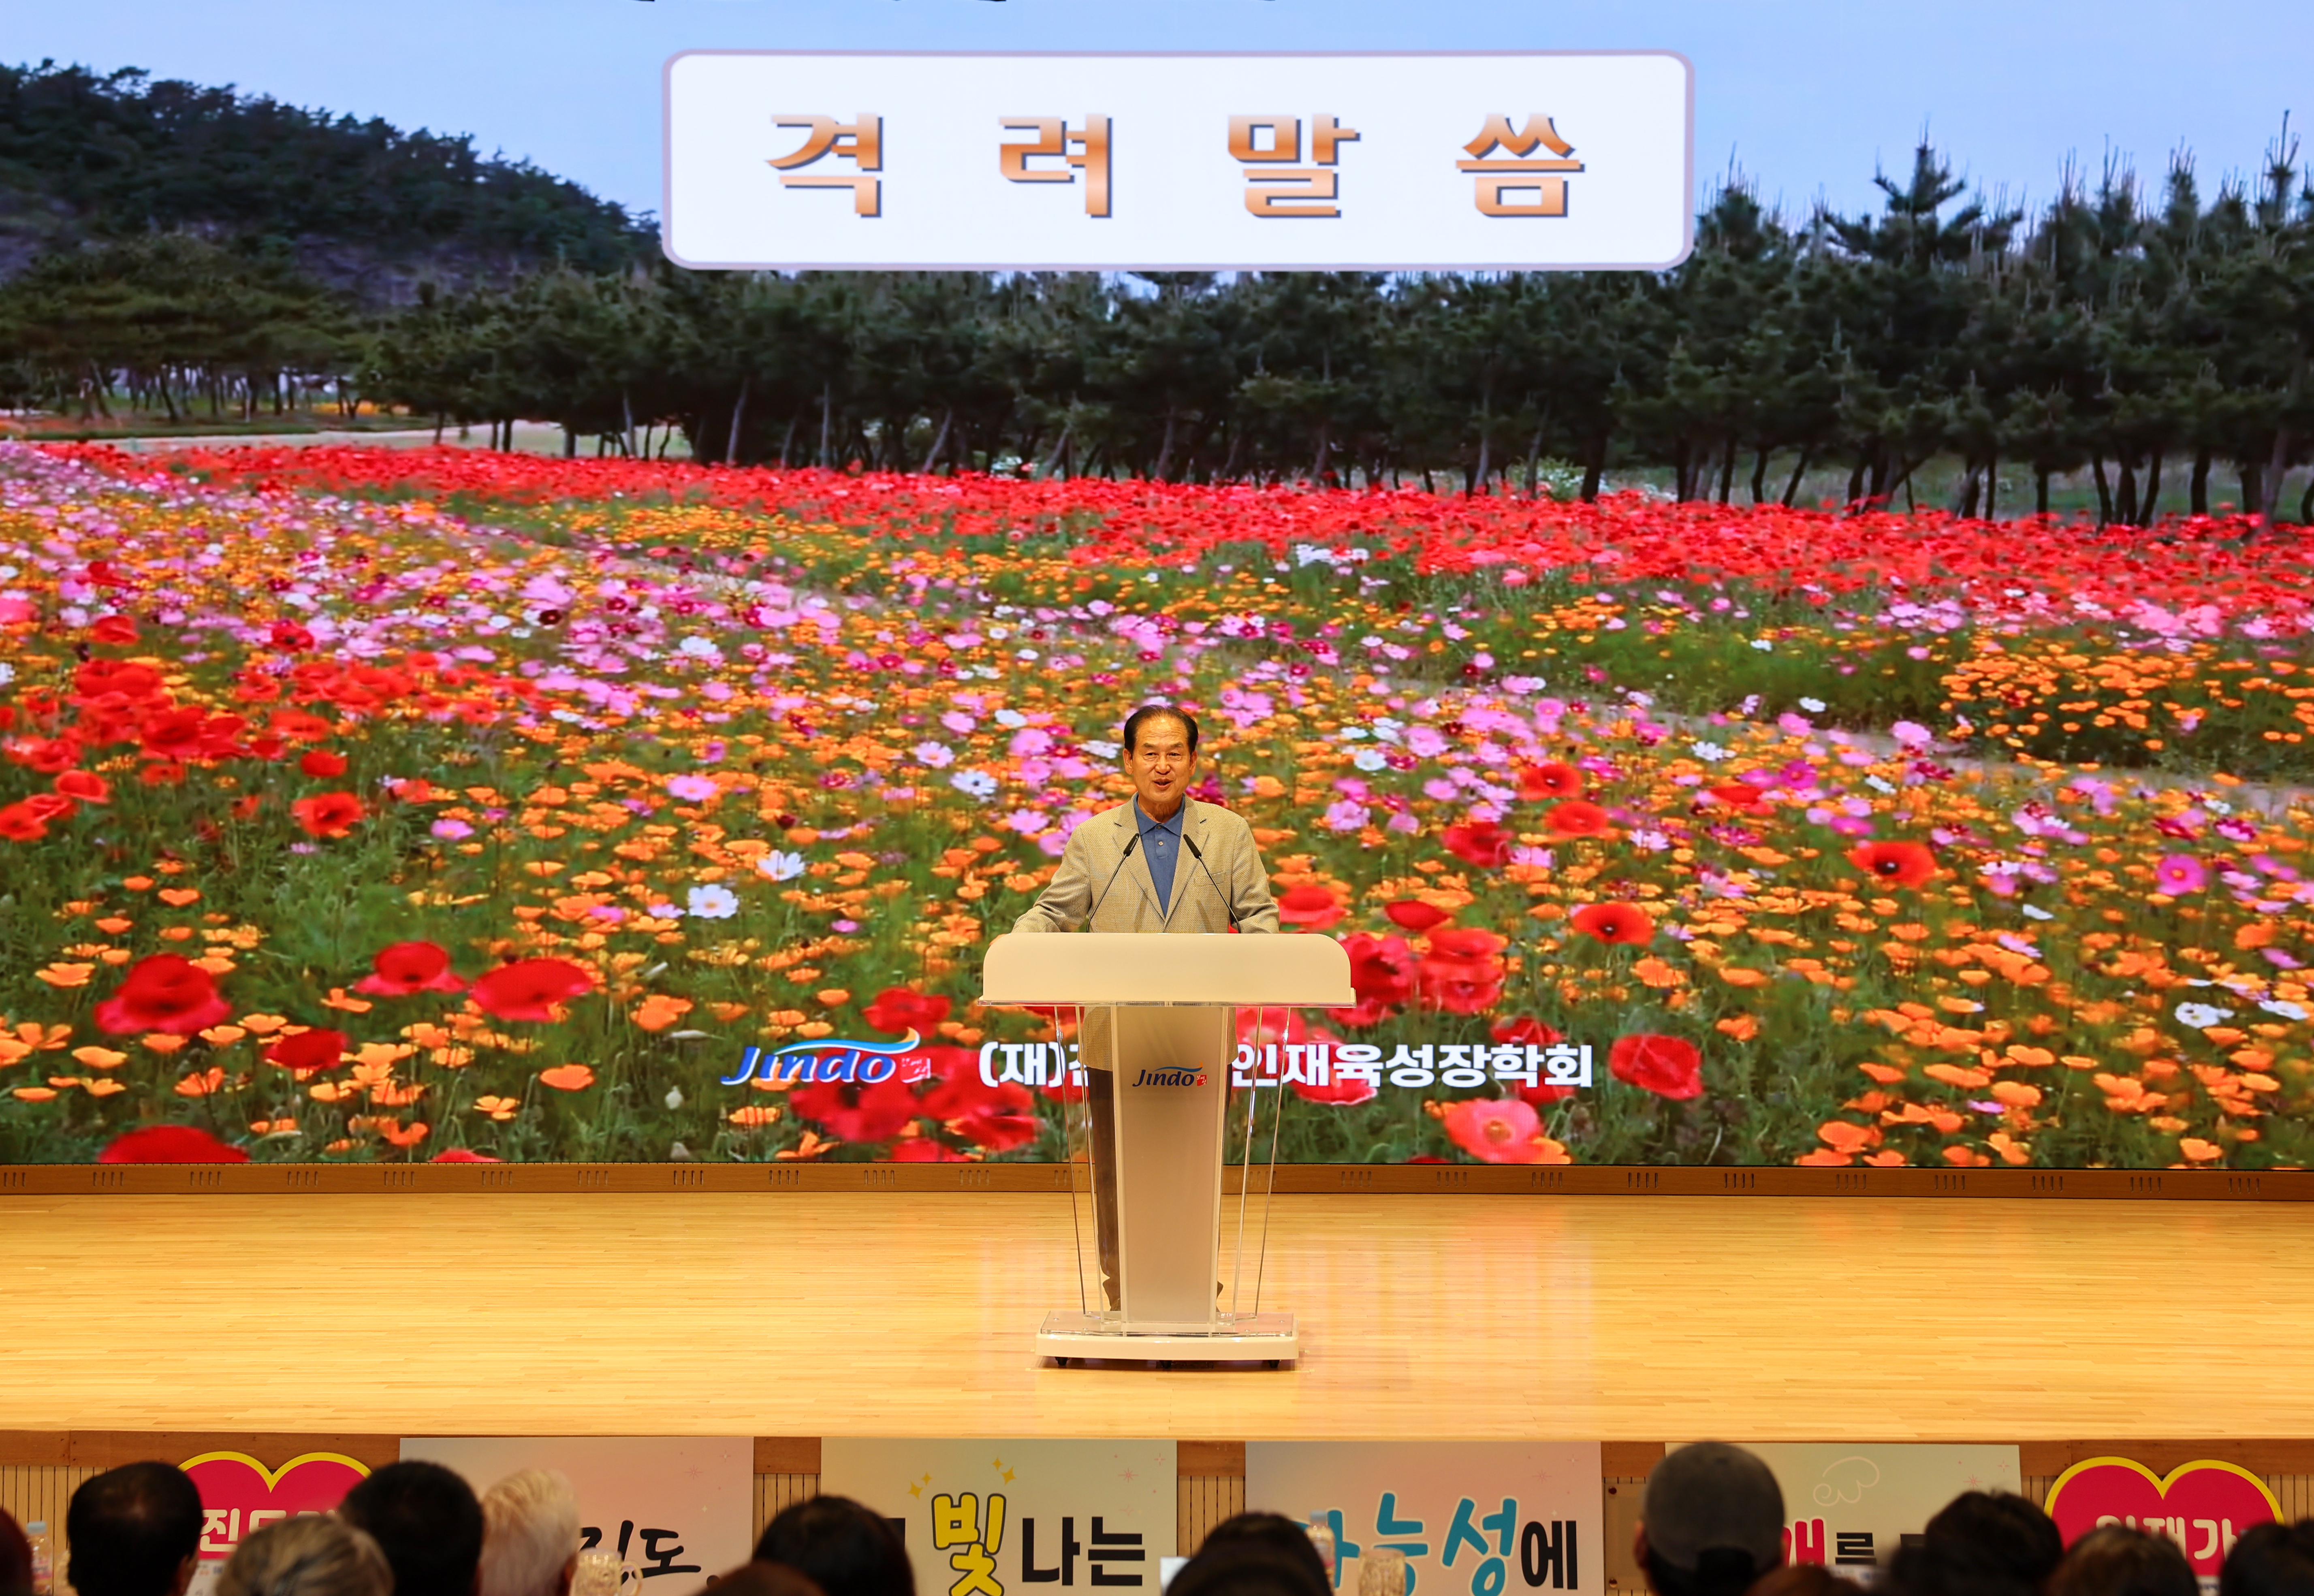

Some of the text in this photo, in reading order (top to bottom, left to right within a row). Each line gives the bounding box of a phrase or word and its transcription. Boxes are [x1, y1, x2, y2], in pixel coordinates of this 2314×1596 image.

[720, 1046, 897, 1086] Jindo
[1132, 1069, 1195, 1087] Jindo
[931, 1492, 1146, 1596] 빛나는
